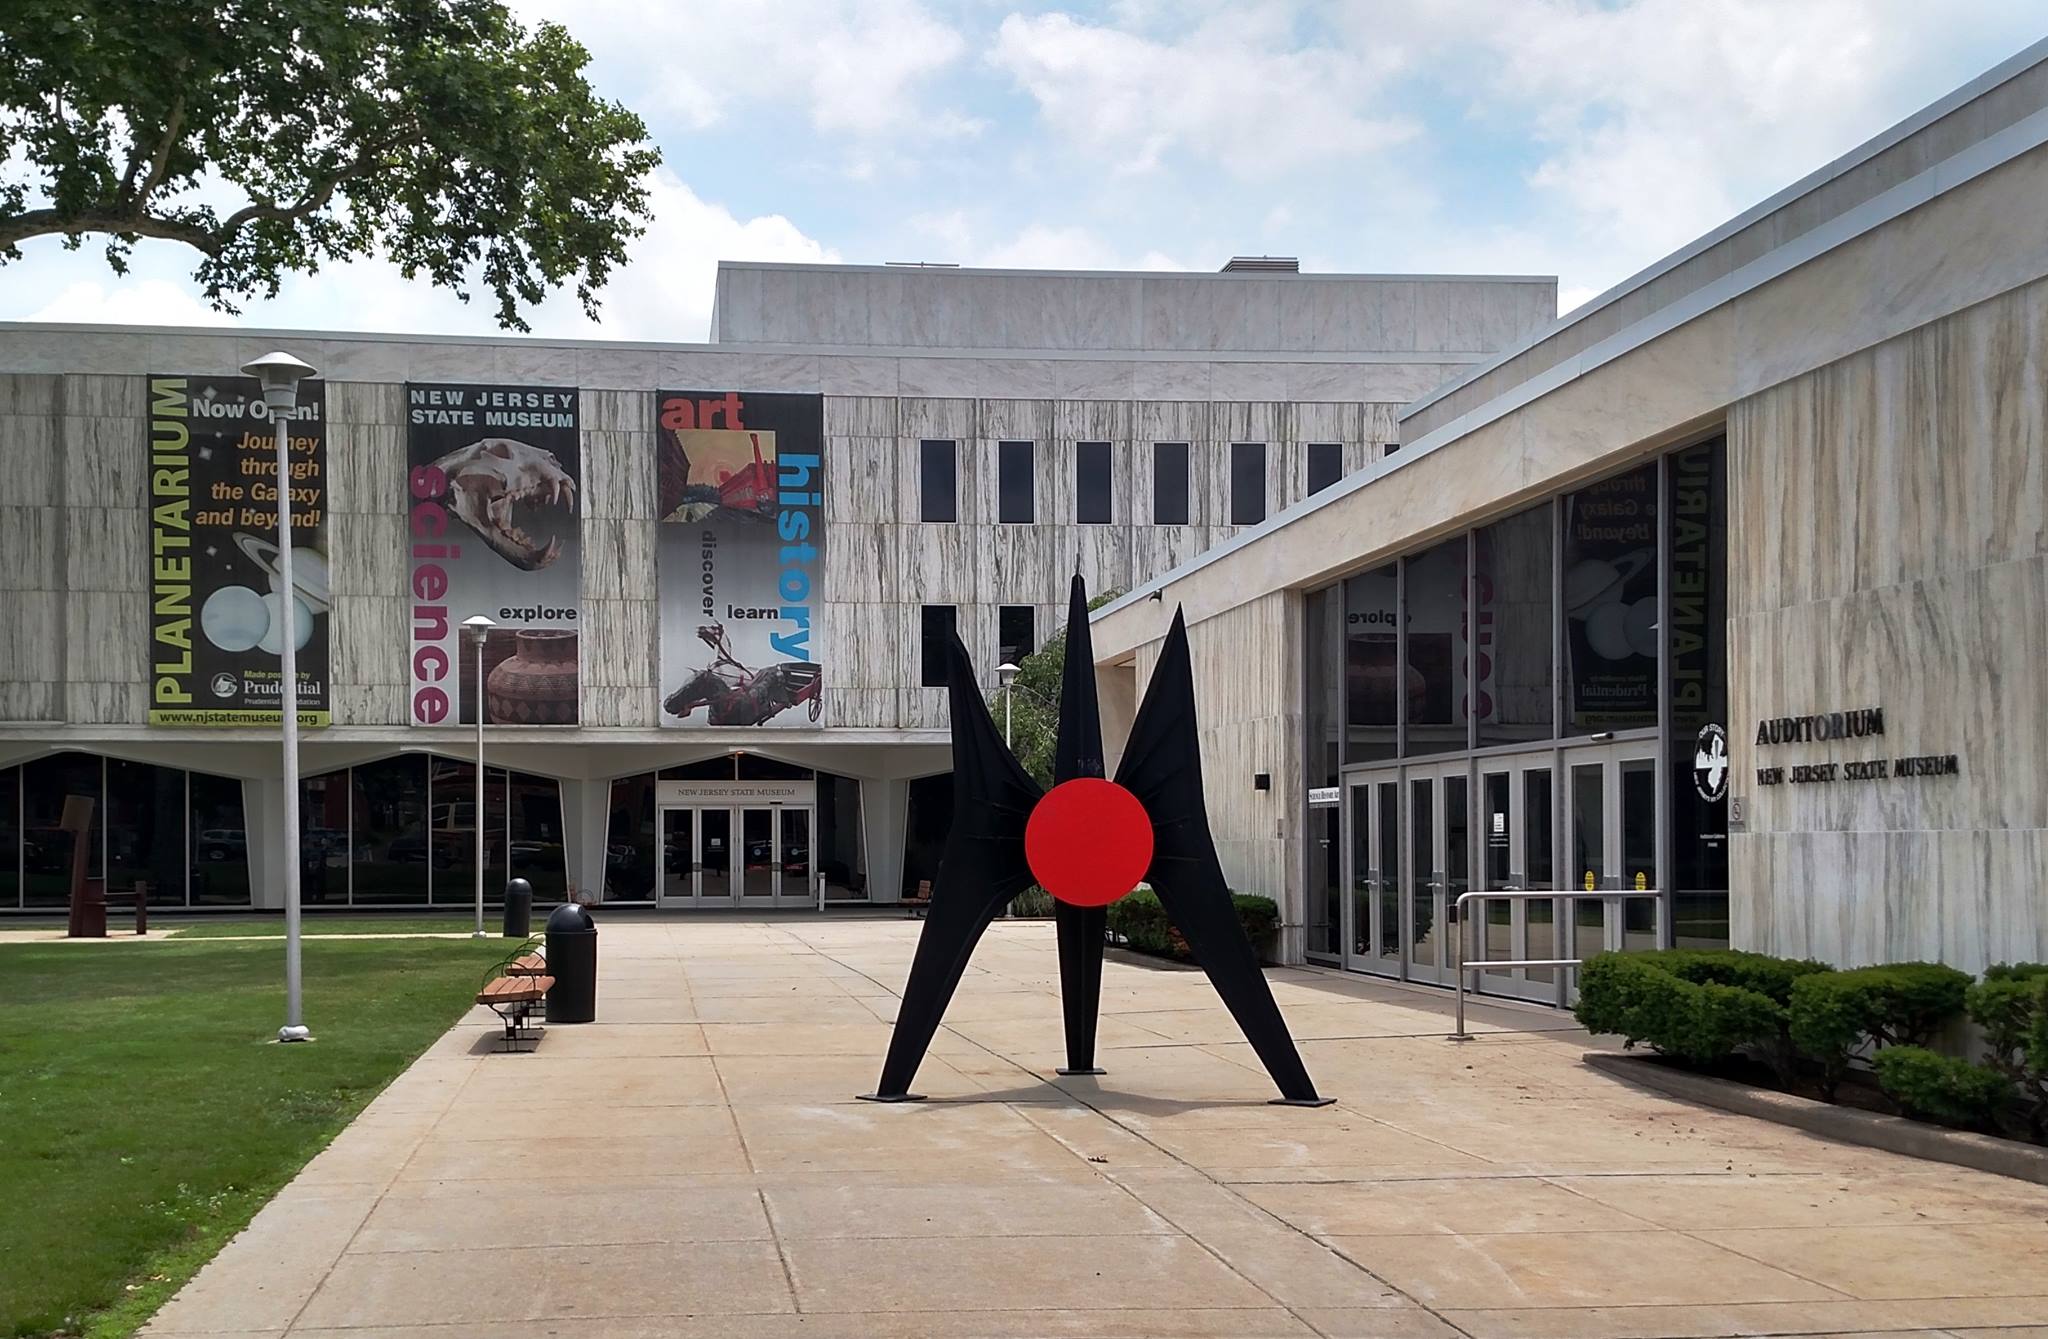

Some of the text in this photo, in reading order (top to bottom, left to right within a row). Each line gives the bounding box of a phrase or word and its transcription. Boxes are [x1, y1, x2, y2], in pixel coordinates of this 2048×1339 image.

[193, 398, 245, 418] Now
[411, 390, 573, 408] NEW JERSEY
[411, 410, 574, 428] STATE MUSEUM
[661, 392, 744, 430] art
[237, 431, 320, 455] Jouney
[241, 457, 319, 480] throgh
[211, 482, 320, 506] the Gaaxy
[195, 507, 321, 530] and beynd!
[152, 378, 192, 703] PLANETARIUM
[770, 453, 821, 662] history
[702, 530, 717, 617] discover
[409, 464, 462, 724] science
[500, 605, 577, 622] explore
[727, 604, 779, 619] learn
[244, 670, 311, 680] Made pose by
[244, 681, 321, 695] Prudtial
[160, 711, 318, 725] www.njstatemuseuorg
[1755, 708, 1884, 746] AUDITORIUM
[1757, 754, 1959, 786] NEW JERSEY STATE MUSEUM
